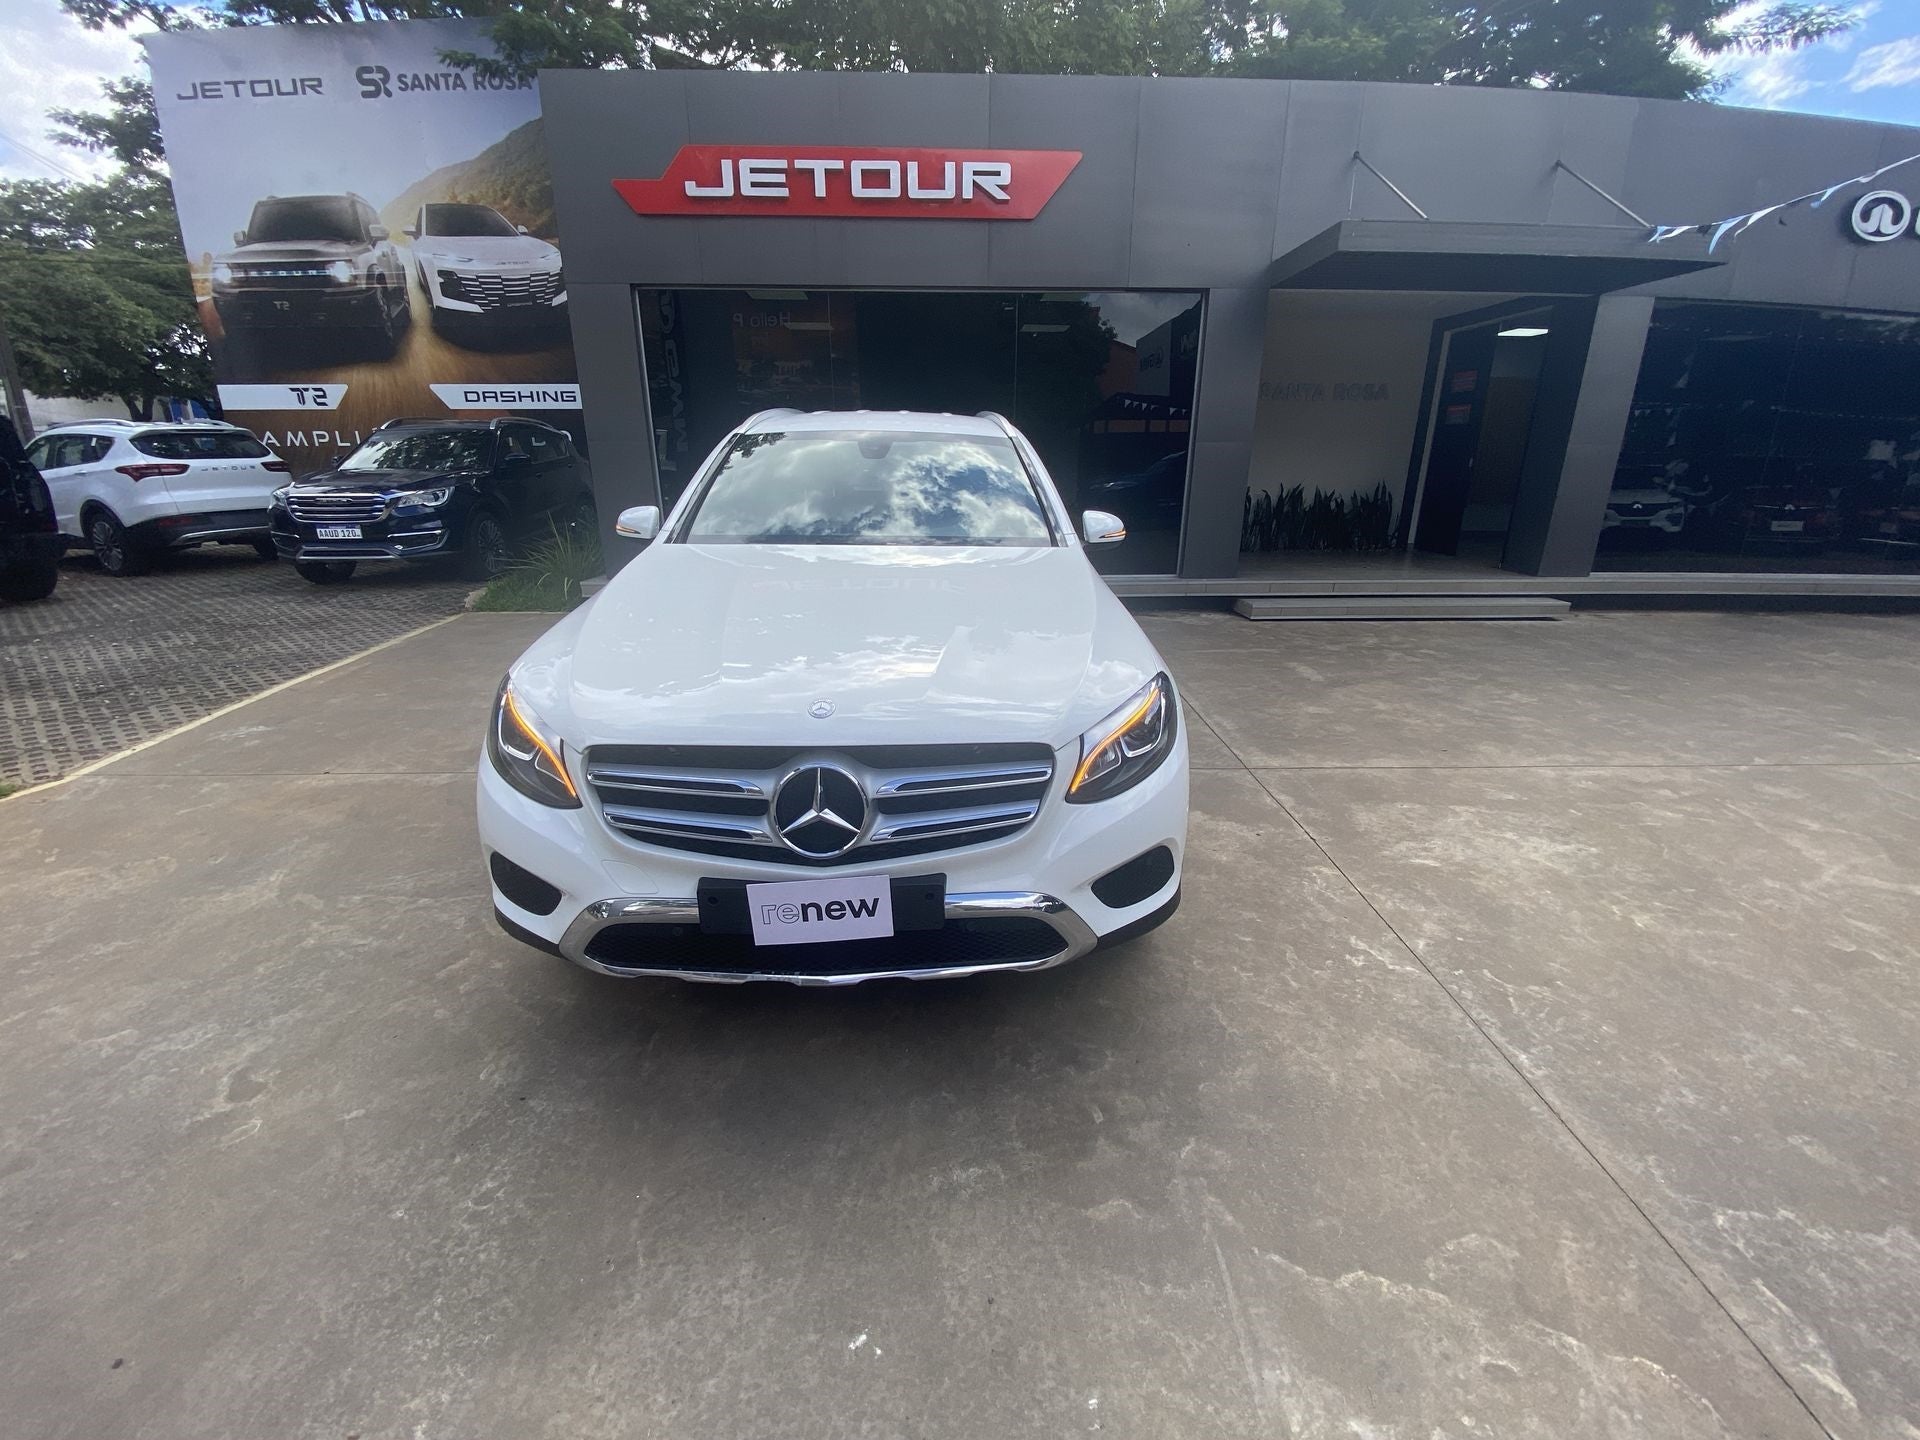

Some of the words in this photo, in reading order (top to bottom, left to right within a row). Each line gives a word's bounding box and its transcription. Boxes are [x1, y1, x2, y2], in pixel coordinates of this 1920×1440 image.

[176, 77, 325, 101] JETOUR
[397, 72, 467, 91] SANTA
[472, 71, 533, 91] ROSA
[684, 158, 1012, 201] JETOUR
[288, 387, 328, 407] T2
[464, 390, 577, 403] DASHING
[262, 428, 379, 447] AMPLI
[761, 897, 880, 925] renew
